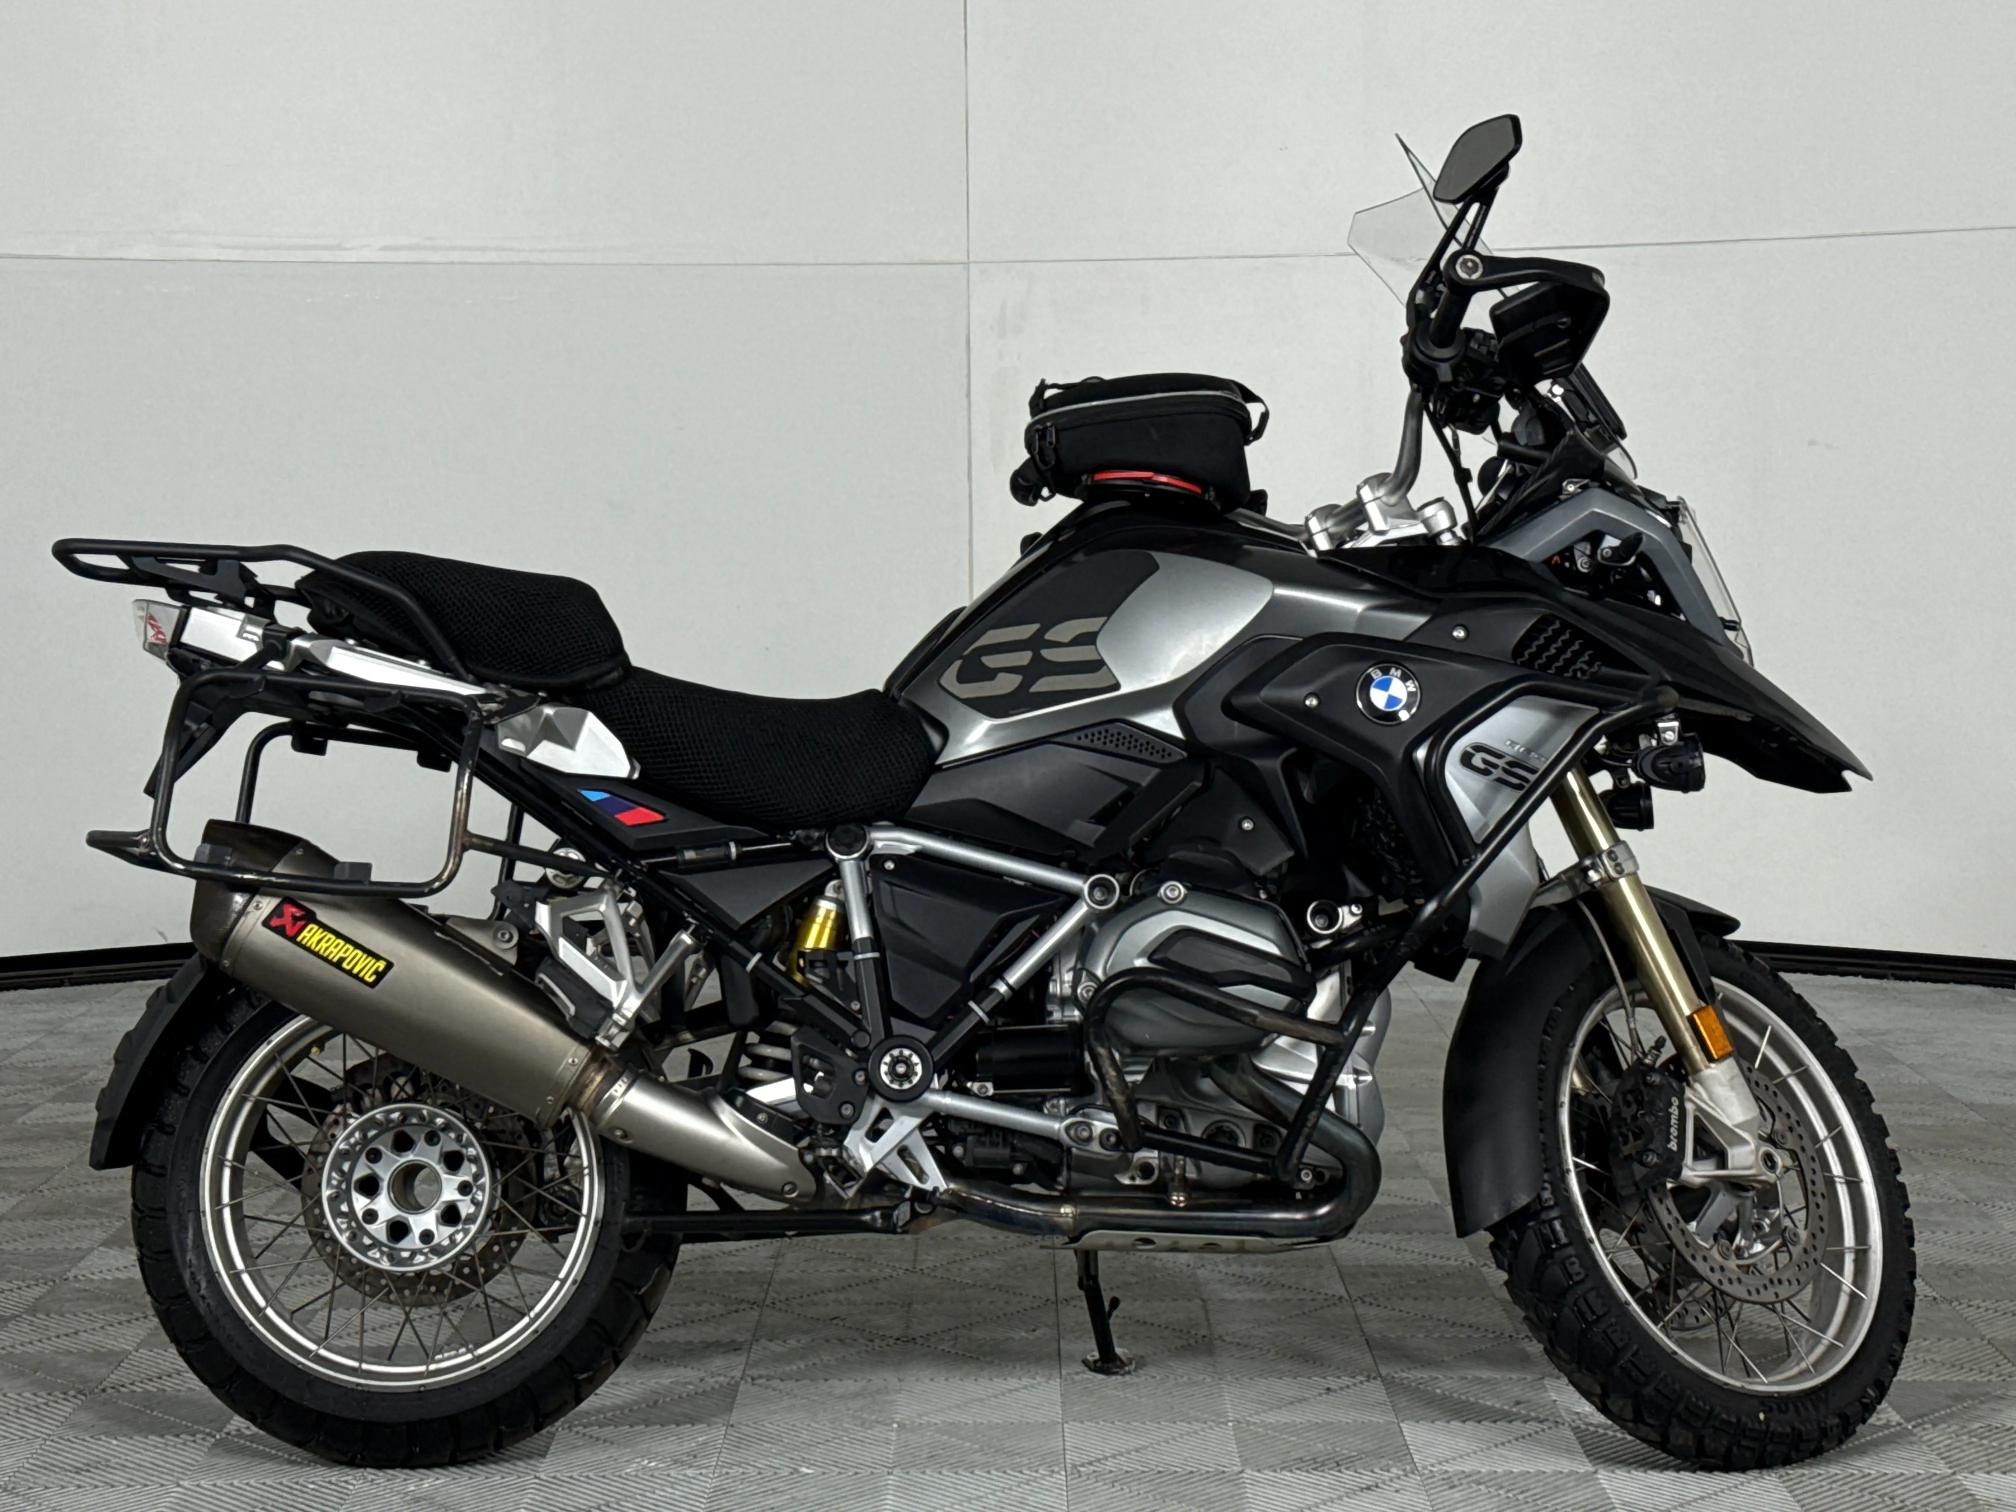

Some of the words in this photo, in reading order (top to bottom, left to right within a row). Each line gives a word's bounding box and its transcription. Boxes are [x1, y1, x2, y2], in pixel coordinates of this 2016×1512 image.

[938, 616, 1116, 699] GS
[1370, 667, 1417, 692] BMW
[1460, 743, 1540, 791] GS
[1667, 1096, 1680, 1152] brembo
